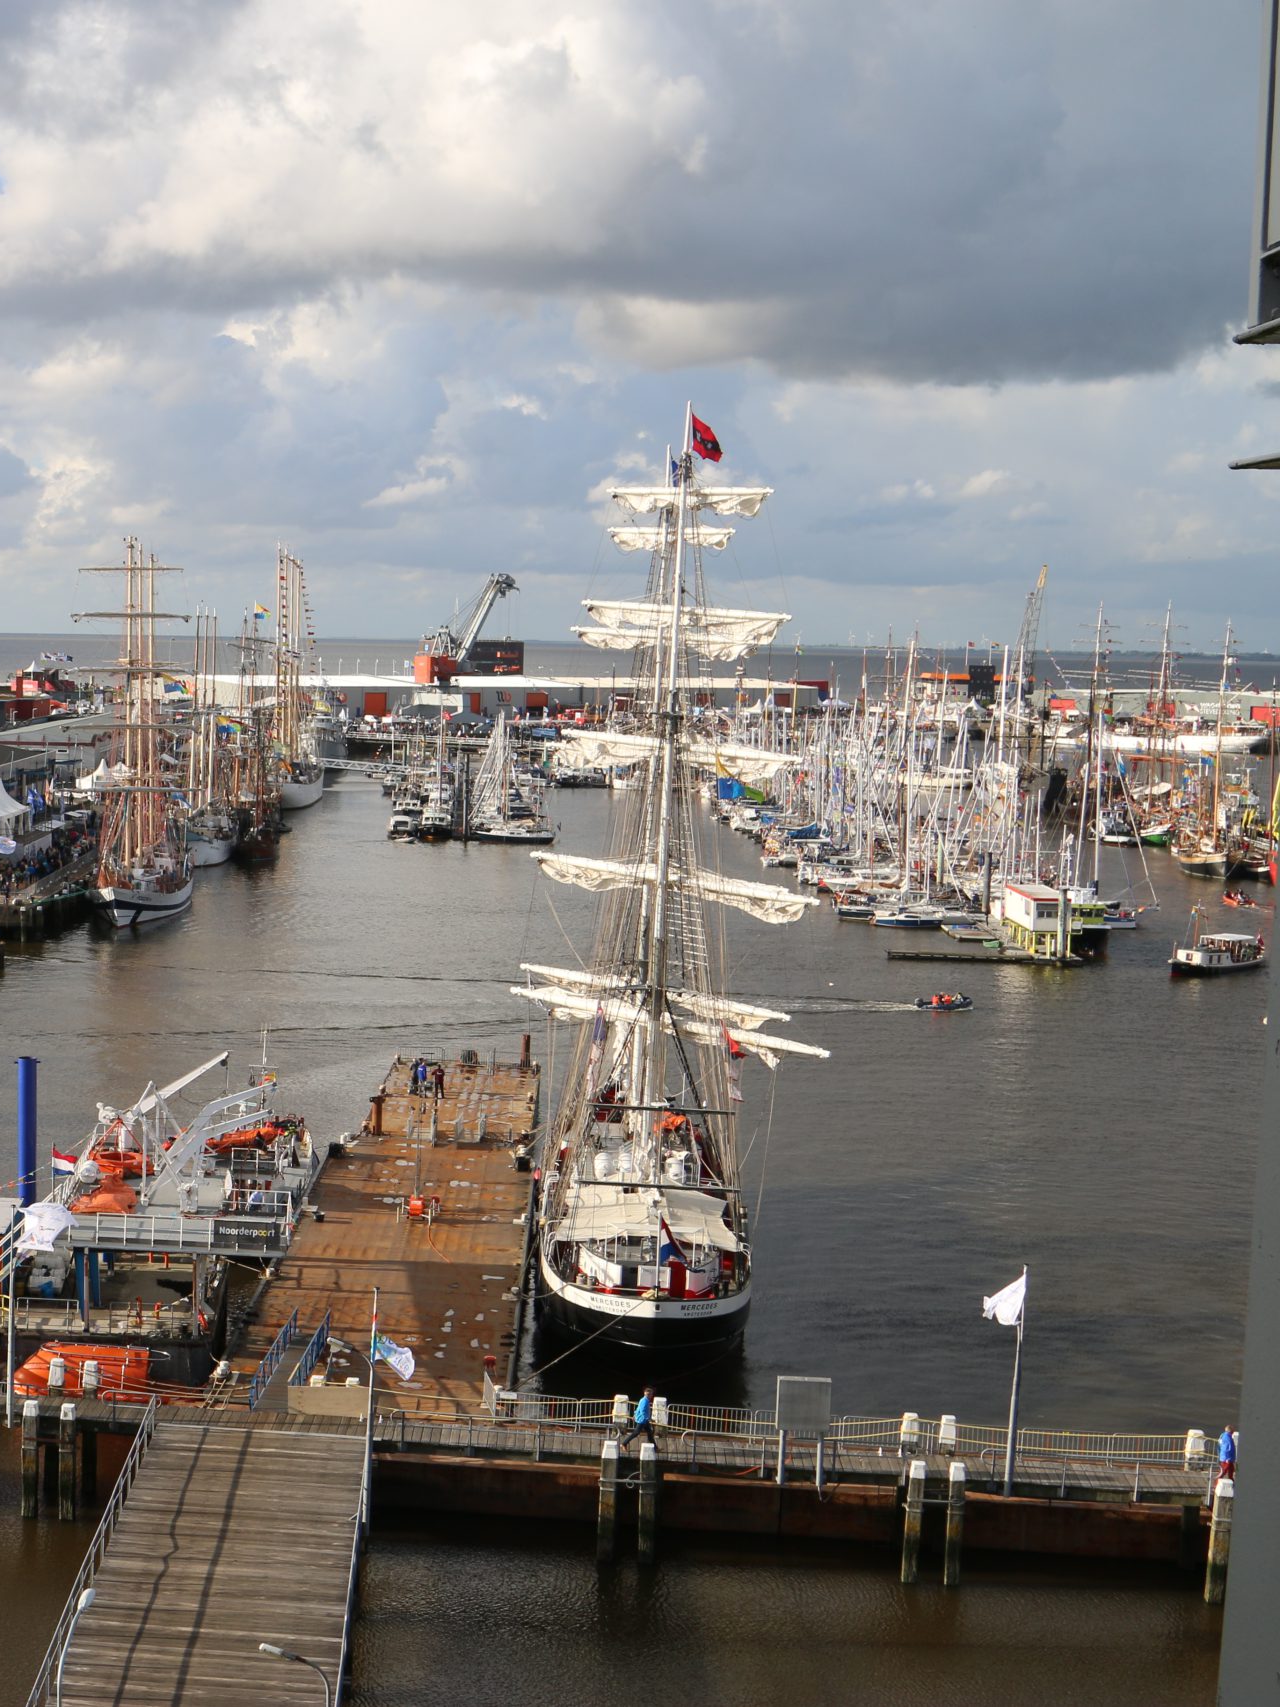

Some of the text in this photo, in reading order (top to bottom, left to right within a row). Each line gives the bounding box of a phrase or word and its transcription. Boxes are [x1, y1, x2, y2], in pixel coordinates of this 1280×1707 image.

[219, 1226, 275, 1238] Noorderpoort
[590, 1295, 631, 1308] MERCEDES
[680, 1302, 718, 1311] MERCEDES
